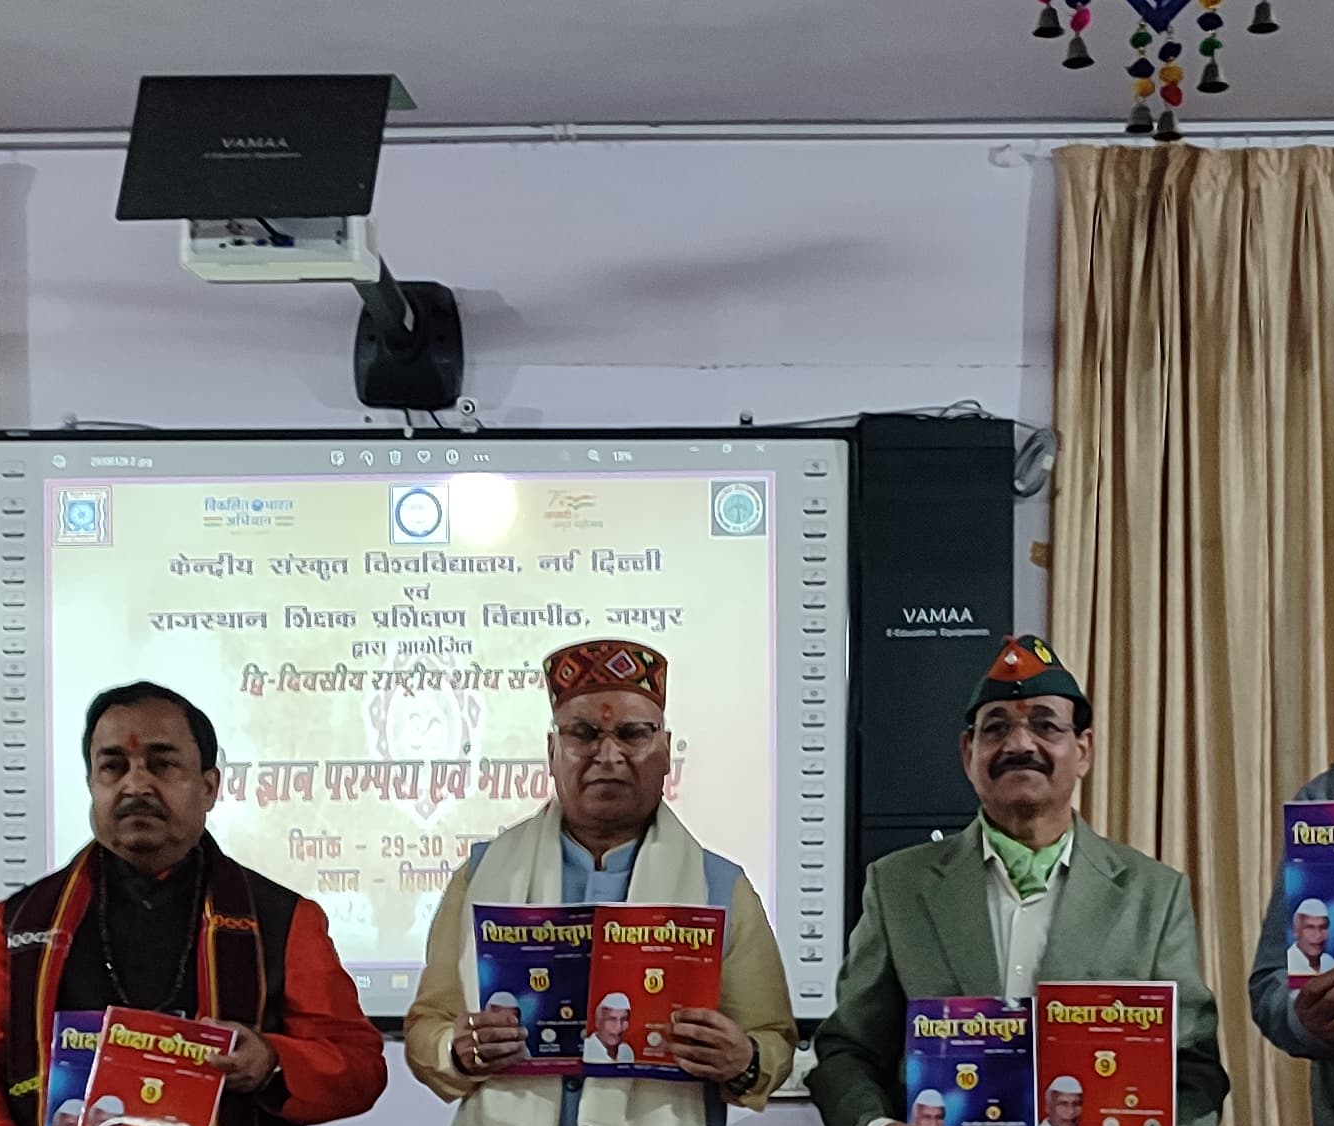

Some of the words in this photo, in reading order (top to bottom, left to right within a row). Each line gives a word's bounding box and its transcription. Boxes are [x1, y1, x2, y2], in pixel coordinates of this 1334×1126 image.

[220, 137, 289, 148] VAMAA
[168, 552, 254, 578] केन्द्रीय
[268, 553, 349, 580] संस्कृत
[538, 550, 581, 573] नई
[591, 549, 663, 575] दिल्ली
[403, 583, 431, 601] एवं
[148, 612, 268, 630] राजस्थान
[284, 605, 357, 629] शिक्षक
[371, 604, 467, 629] प्रशिक्षण
[605, 607, 684, 631] जयपुर
[902, 607, 973, 624] VAMAA
[352, 640, 386, 659] द्वारा
[397, 635, 473, 656] आयोजित
[371, 662, 445, 698] राष्ट्रीय
[451, 661, 504, 691] शोध
[256, 760, 319, 808] ज्ञान
[324, 759, 425, 801] परम्परा
[428, 741, 472, 804] एवं
[288, 828, 343, 860] दिनांक
[380, 834, 444, 859] 29-30
[317, 868, 361, 893] स्थान
[398, 859, 452, 894] विद्यापी
[480, 919, 528, 944] शिक्षा
[603, 920, 650, 945] शिक्षा
[1045, 1000, 1097, 1025] शिक्षा
[60, 1026, 99, 1051] शिक्ष
[107, 1023, 155, 1051] शिक्षा
[913, 1013, 960, 1039] शिक्षा
